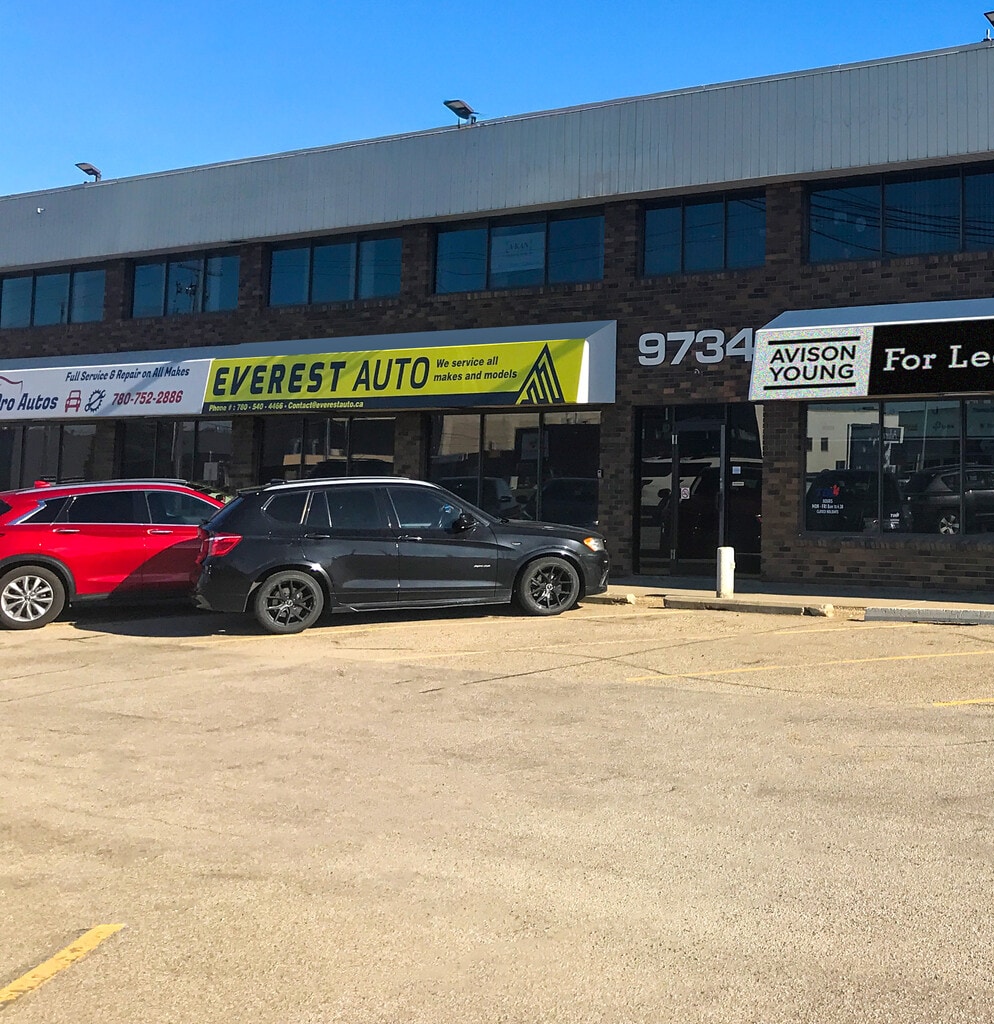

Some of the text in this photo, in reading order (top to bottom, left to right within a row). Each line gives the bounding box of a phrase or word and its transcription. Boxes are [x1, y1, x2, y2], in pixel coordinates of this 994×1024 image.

[638, 327, 756, 366] 9734
[769, 344, 857, 364] AVISON
[436, 356, 499, 368] We service all
[882, 347, 937, 372] For
[65, 371, 80, 382] Full
[80, 369, 108, 381] Service
[116, 368, 141, 382] Repair
[142, 370, 151, 379] on
[152, 367, 163, 378] All
[164, 366, 190, 377] Makes
[212, 356, 430, 397] EVEREST AUTO
[433, 369, 518, 382] makes and models
[769, 363, 855, 382] YOUNG
[0, 392, 59, 411] ro Autos
[111, 390, 184, 405] 780-752-2886
[208, 404, 227, 412] Phone
